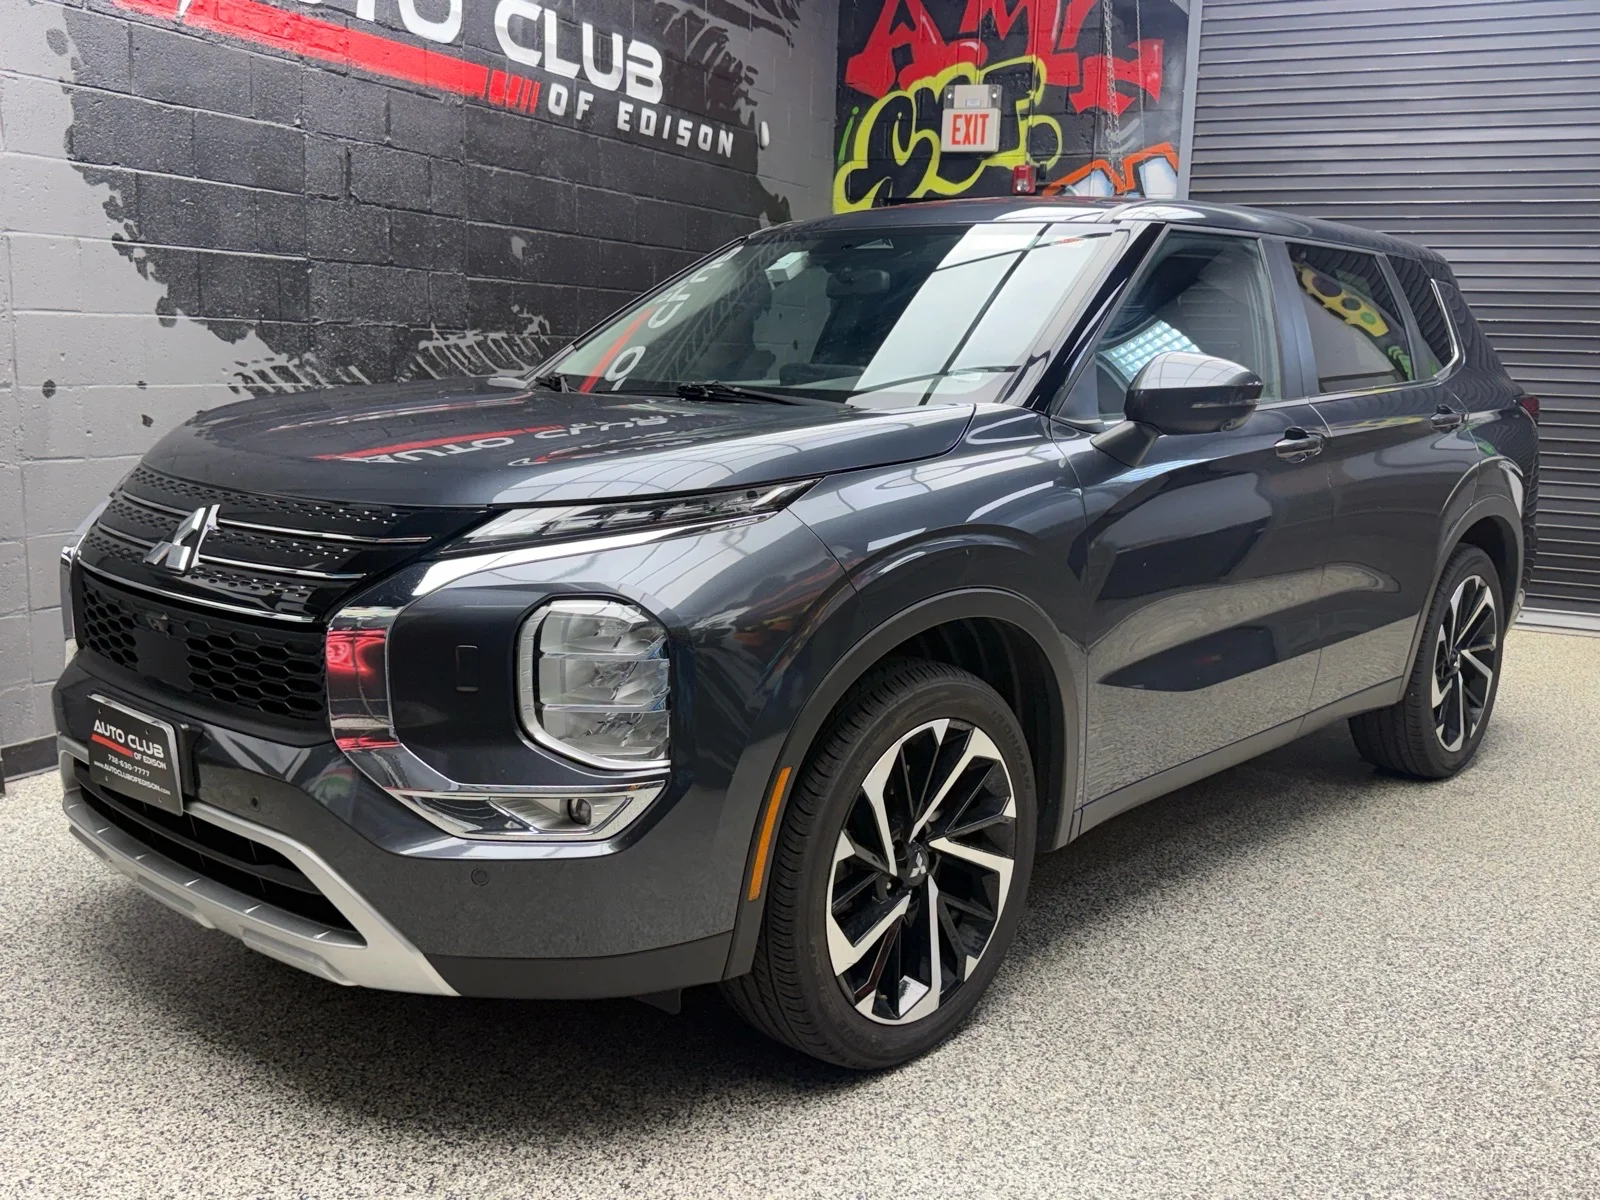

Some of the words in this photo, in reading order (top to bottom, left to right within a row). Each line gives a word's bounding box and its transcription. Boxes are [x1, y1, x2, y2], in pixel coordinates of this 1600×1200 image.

[494, 0, 663, 104] CLUB
[548, 83, 594, 120] OF
[617, 100, 734, 158] EDISON
[951, 113, 990, 146] EXIT
[93, 719, 126, 743] AUTO
[127, 734, 164, 758] CLUB
[133, 752, 142, 761] OF
[143, 755, 167, 770] EDISON
